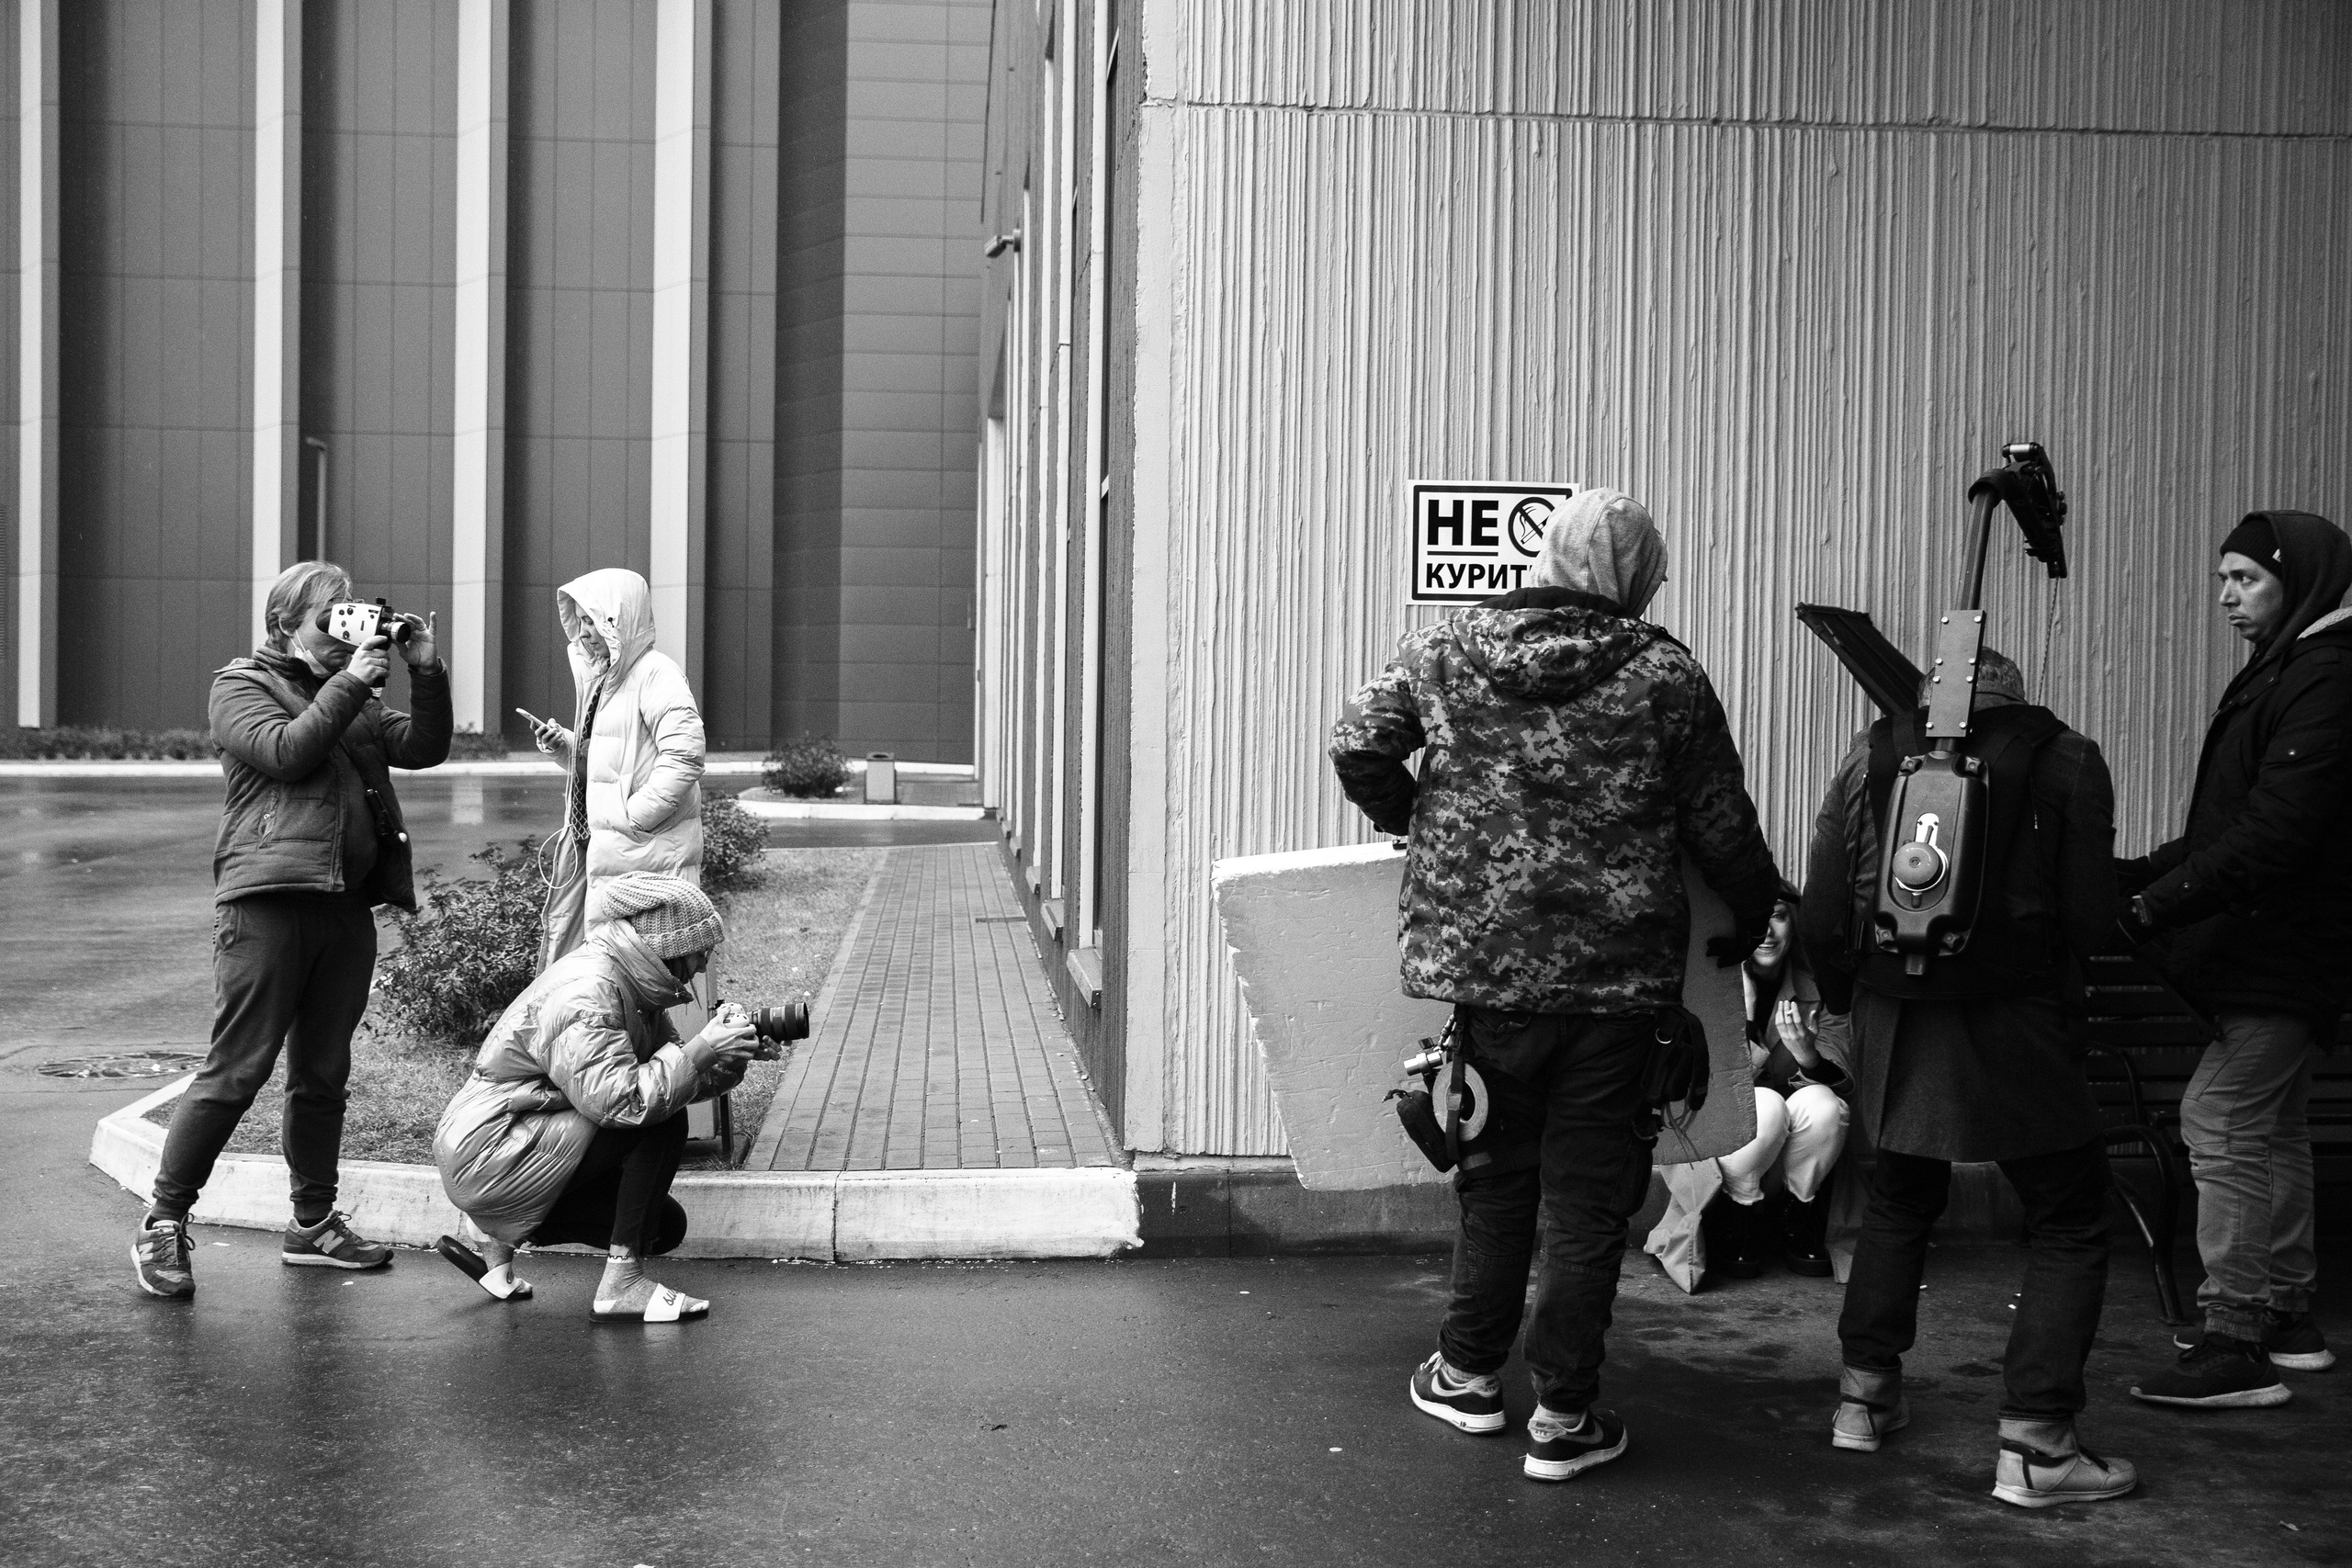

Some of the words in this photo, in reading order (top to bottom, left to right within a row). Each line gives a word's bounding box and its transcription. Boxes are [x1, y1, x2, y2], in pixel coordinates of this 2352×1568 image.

[1427, 499, 1499, 547] НЕ
[1426, 562, 1533, 590] КУРИТ
[312, 1229, 345, 1255] N
